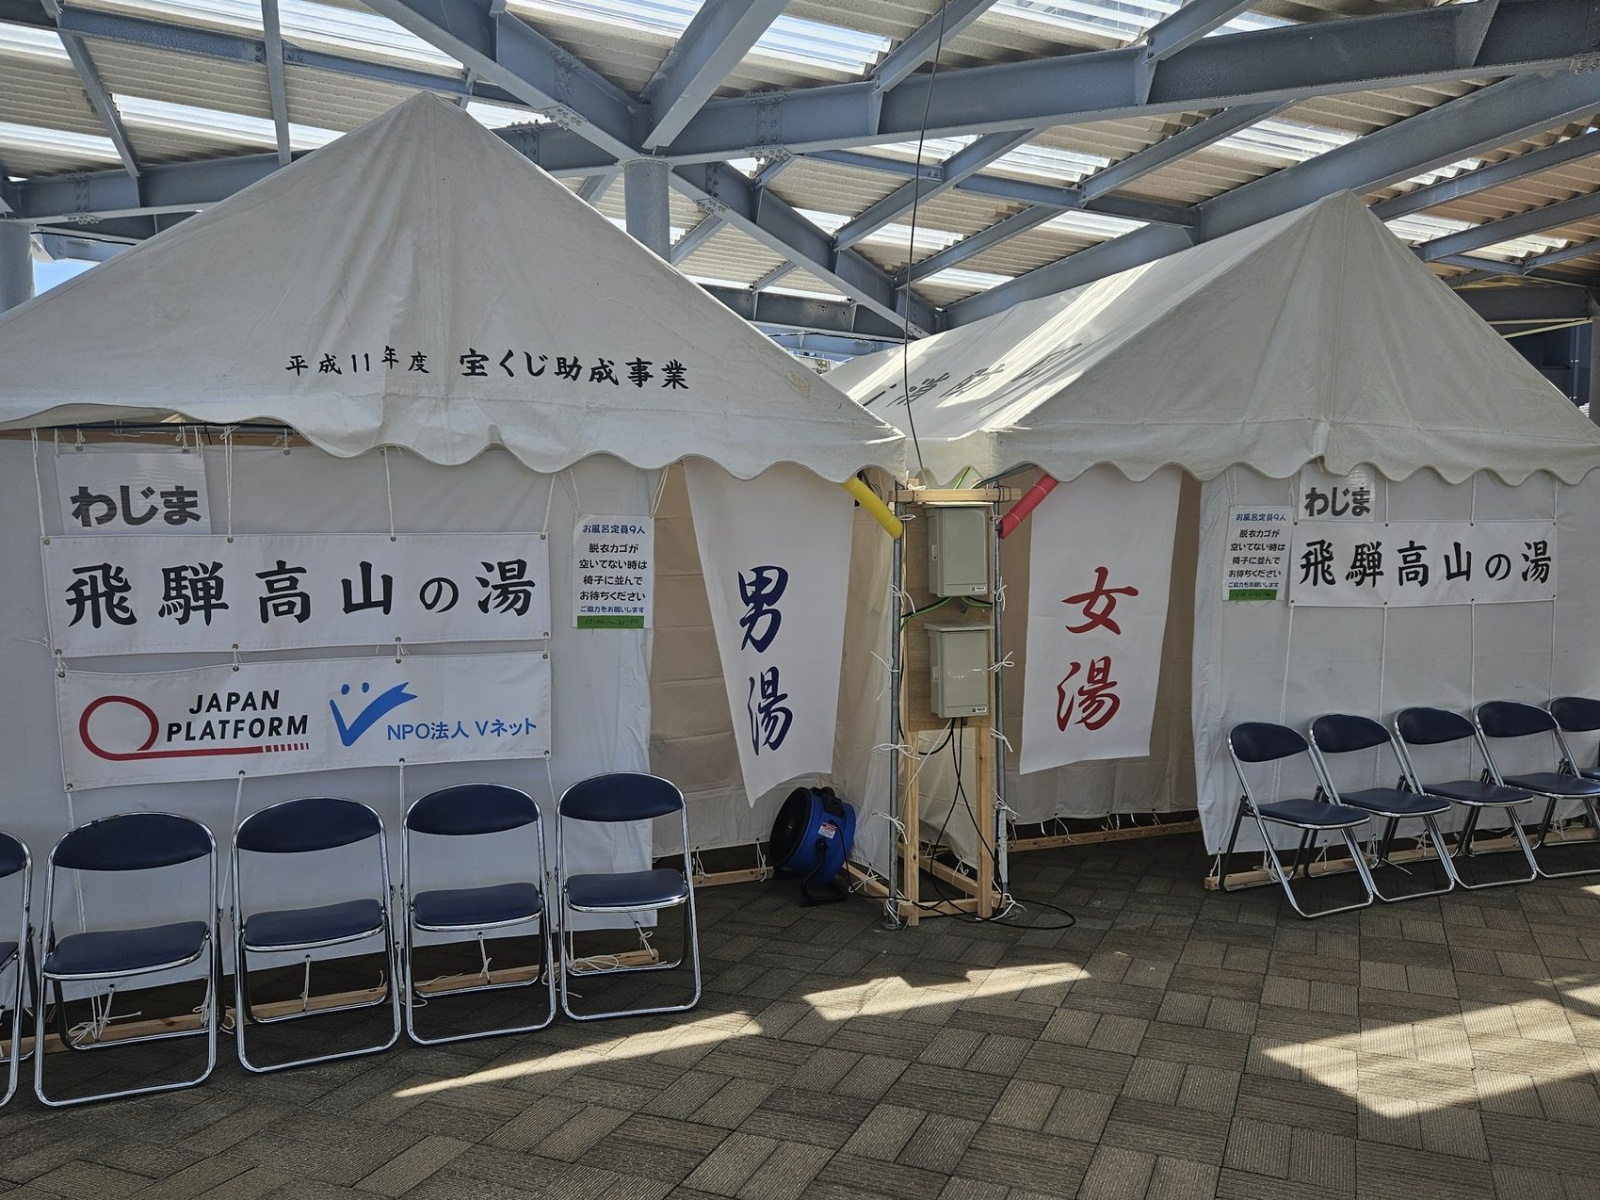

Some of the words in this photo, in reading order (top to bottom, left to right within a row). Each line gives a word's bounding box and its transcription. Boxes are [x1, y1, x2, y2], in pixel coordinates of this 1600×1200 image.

[285, 345, 430, 376] 平成11年度
[459, 347, 689, 390] 宝くじ助成事業
[70, 484, 202, 528] わじま
[1304, 486, 1371, 517] わじま
[1239, 529, 1280, 538] 脱衣カゴが
[588, 543, 639, 554] 脱衣カゴが
[1230, 542, 1286, 552] 空いてない時は
[579, 558, 648, 570] 空いてない時は
[1232, 556, 1281, 565] 椅子に並んで
[1299, 539, 1552, 589] 飛騨高山の湯
[583, 574, 643, 586] 椅子に並んで
[1228, 569, 1282, 578] お待ちください
[64, 558, 537, 629] 飛騨高山の湯
[579, 590, 646, 602] お待ちください
[580, 605, 645, 613] ご協力をお願いします
[737, 565, 794, 757] 男湯
[1056, 566, 1139, 732] 女湯
[188, 689, 280, 715] JAPAN
[166, 714, 309, 742] PLATFORM
[387, 722, 469, 741] NPO法人
[475, 717, 537, 737] Vネット
